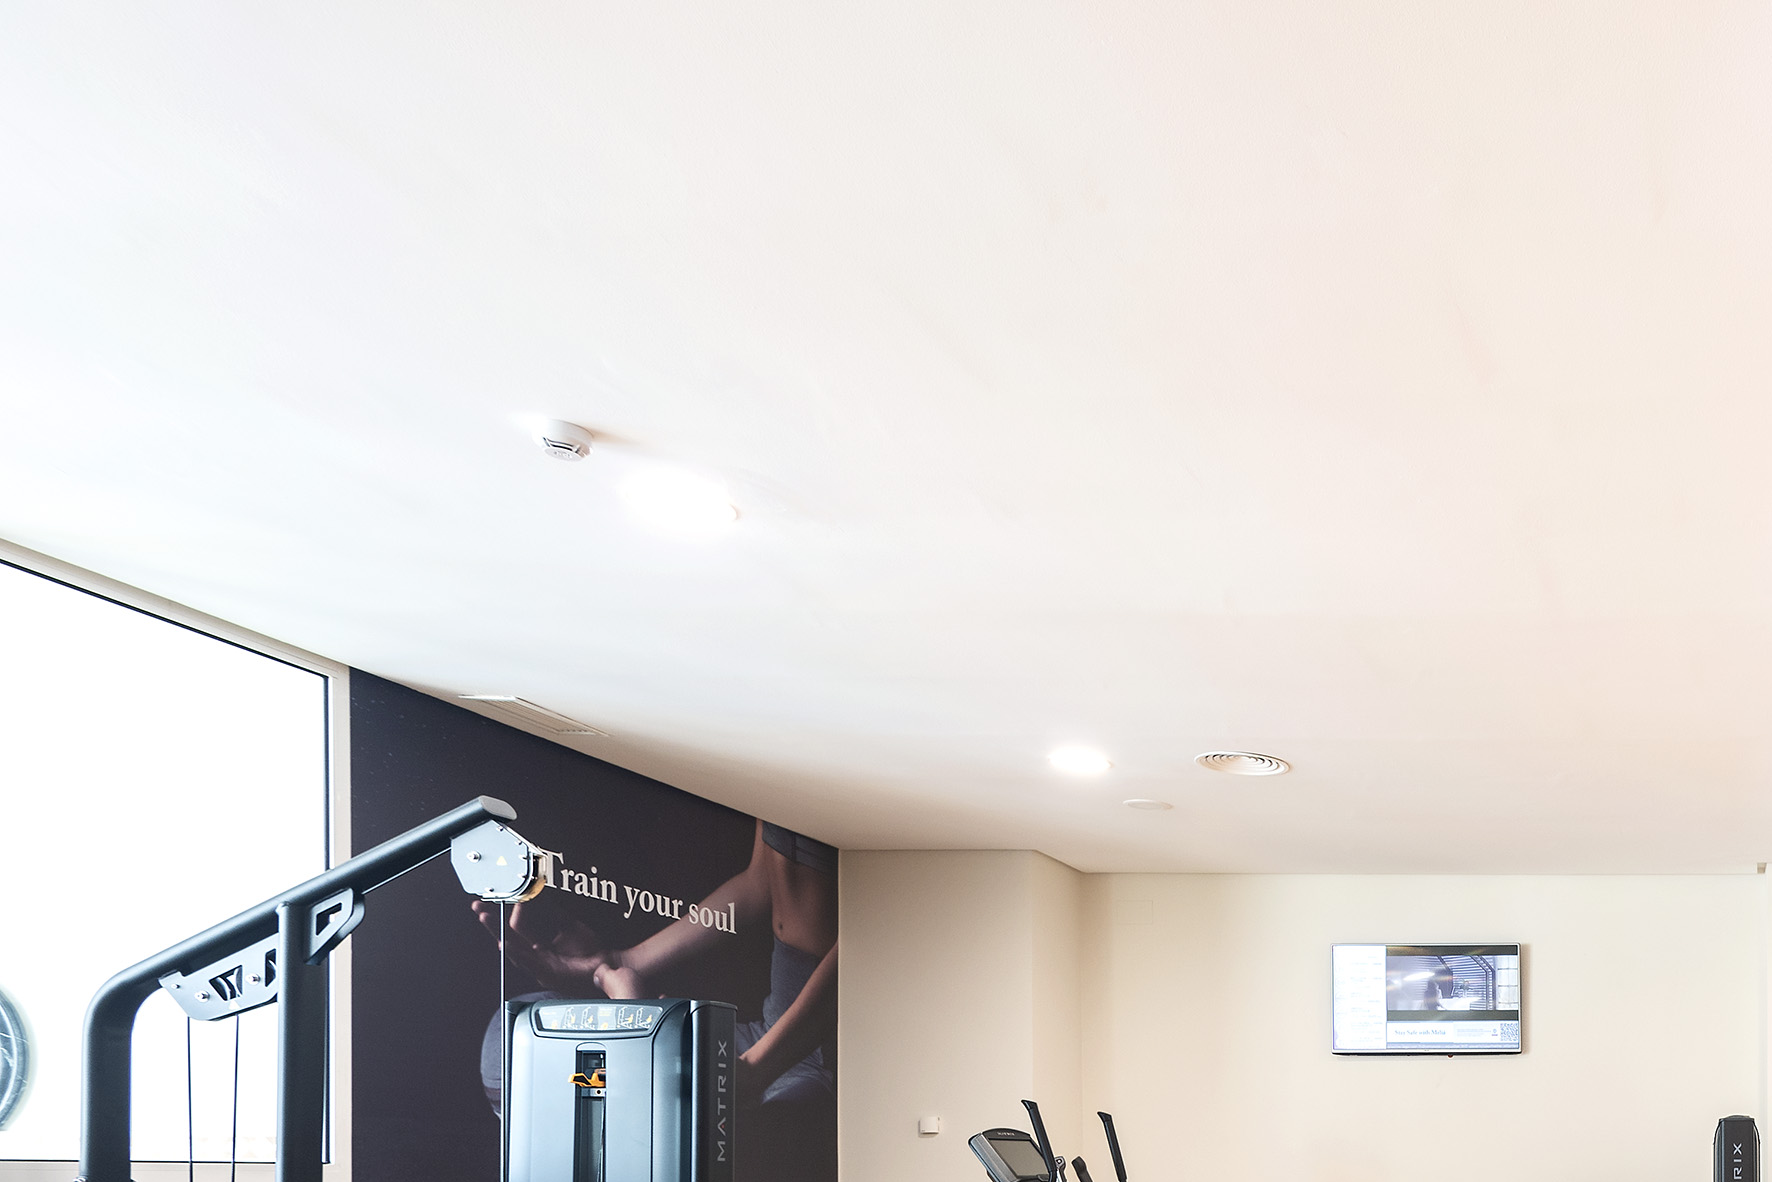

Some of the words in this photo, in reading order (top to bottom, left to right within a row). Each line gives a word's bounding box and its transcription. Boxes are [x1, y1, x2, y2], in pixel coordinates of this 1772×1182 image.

[538, 846, 619, 904] Train
[623, 885, 684, 919] your
[688, 902, 737, 934] soul
[716, 1040, 727, 1162] MATRIX
